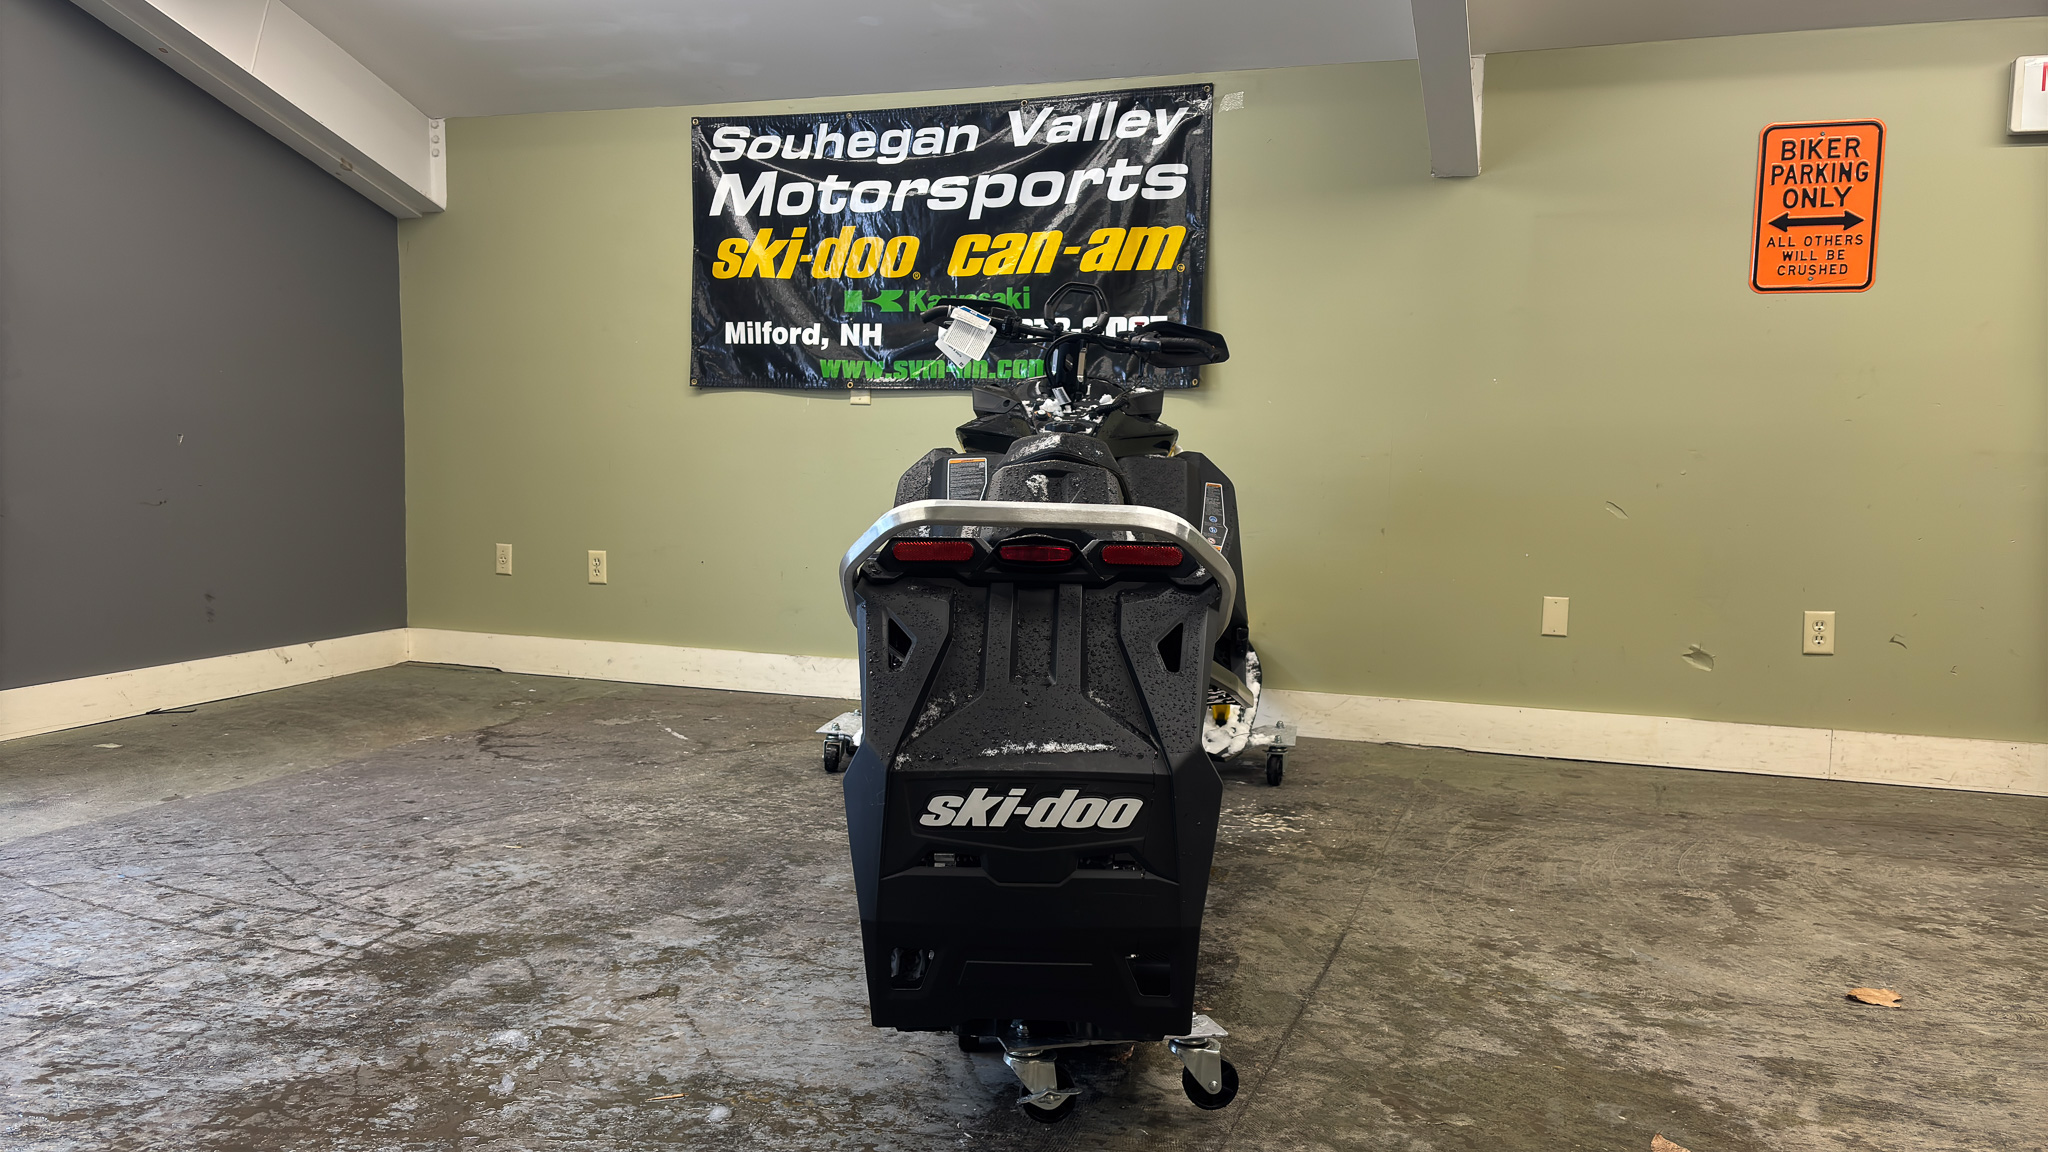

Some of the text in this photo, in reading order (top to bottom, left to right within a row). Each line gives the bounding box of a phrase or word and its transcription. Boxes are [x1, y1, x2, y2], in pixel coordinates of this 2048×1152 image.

[709, 101, 1190, 165] Souhegan Valley
[1780, 136, 1862, 161] BIKER
[1770, 161, 1870, 185] PARKING
[708, 158, 1189, 220] Motorsports
[1782, 186, 1853, 209] ONLY
[1766, 234, 1864, 248] ALL OTHERS
[1782, 249, 1846, 262] WILL BE
[1776, 264, 1849, 276] CRUSHED
[908, 286, 1031, 312] Kaaki
[724, 321, 883, 350] Milford, NH
[918, 787, 1144, 829] ski-doo
